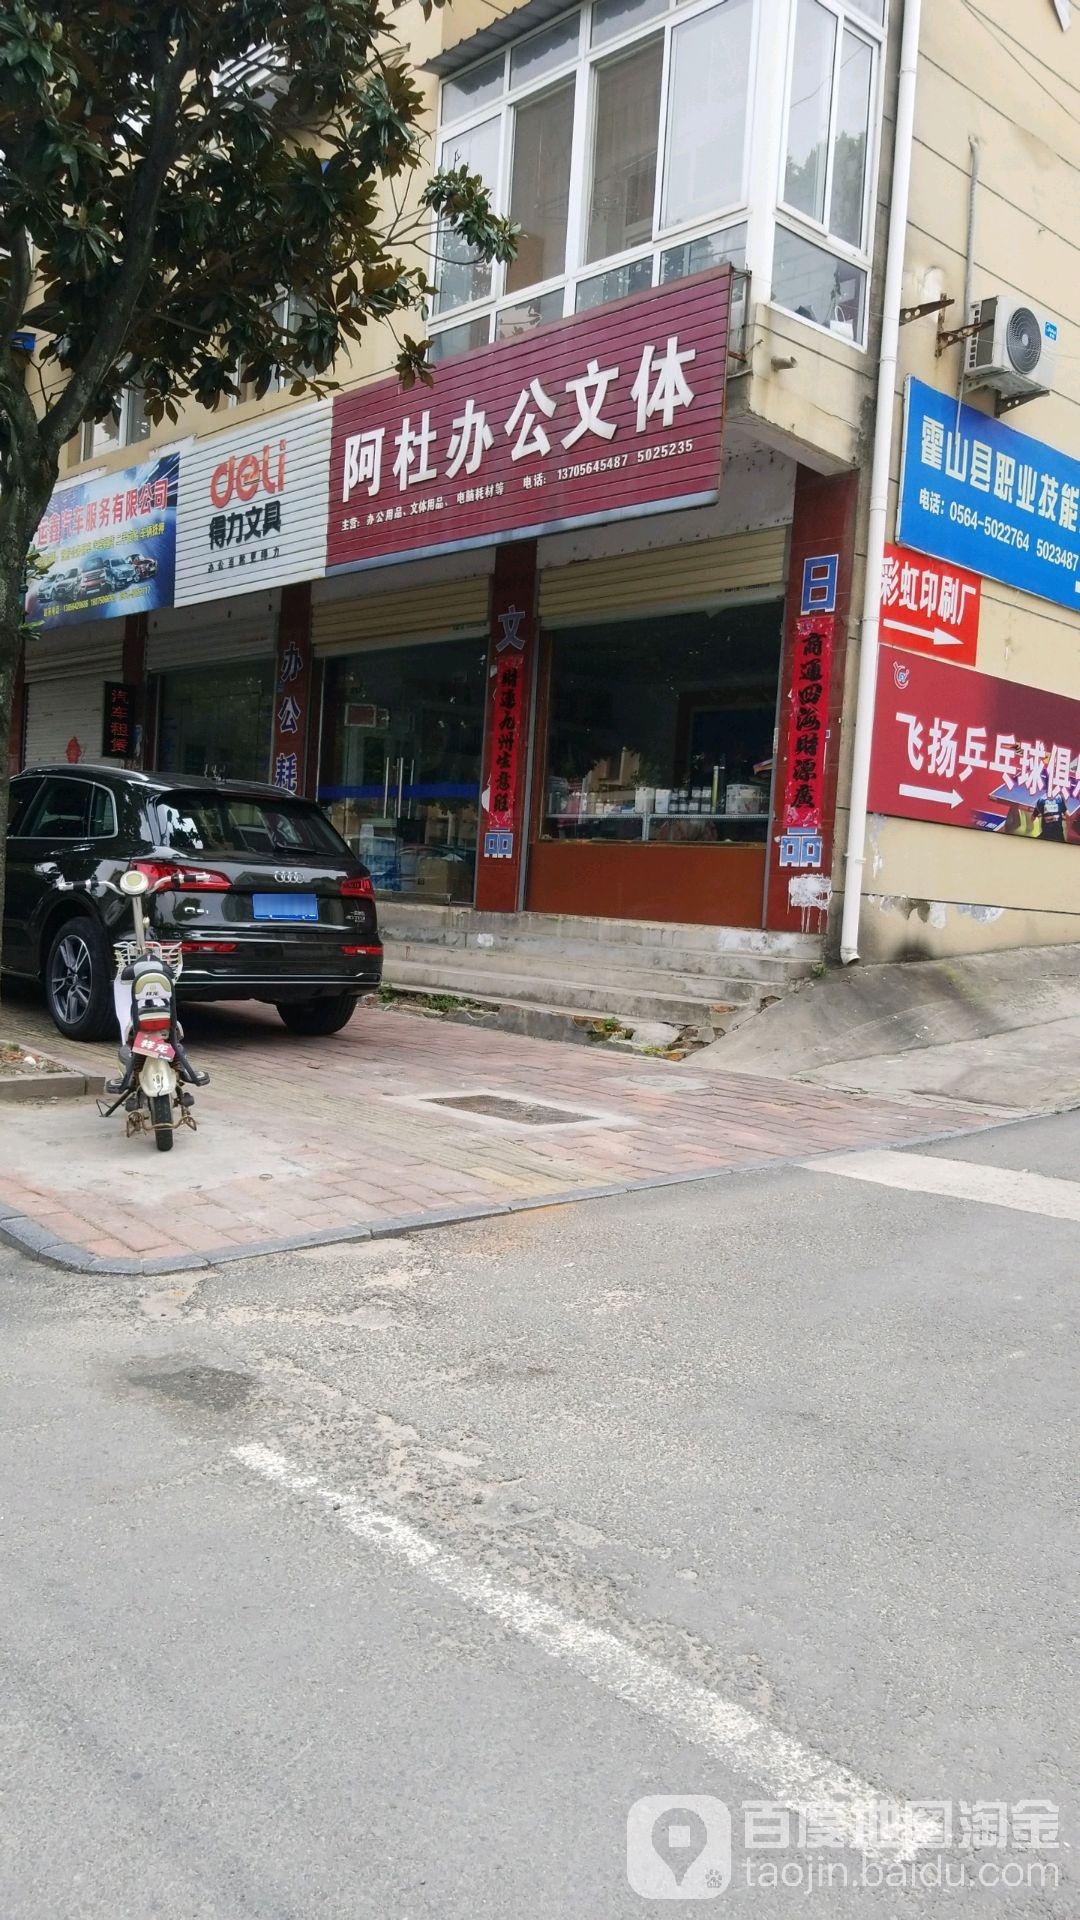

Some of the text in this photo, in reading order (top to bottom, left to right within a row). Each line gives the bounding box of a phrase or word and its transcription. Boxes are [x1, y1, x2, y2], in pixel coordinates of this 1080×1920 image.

[342, 335, 696, 503] 阿杜办公文体
[210, 438, 287, 509] deli
[557, 454, 628, 481] 13705645487
[637, 439, 693, 464] 5025235
[921, 414, 1079, 532] 霍山县职业技能
[209, 500, 281, 550] 得力文具
[949, 501, 1030, 552] 0564-5022764
[1036, 538, 1079, 572] 5023487
[879, 556, 976, 625] 彩虹印刷厂
[110, 688, 129, 753] 汽车租赁
